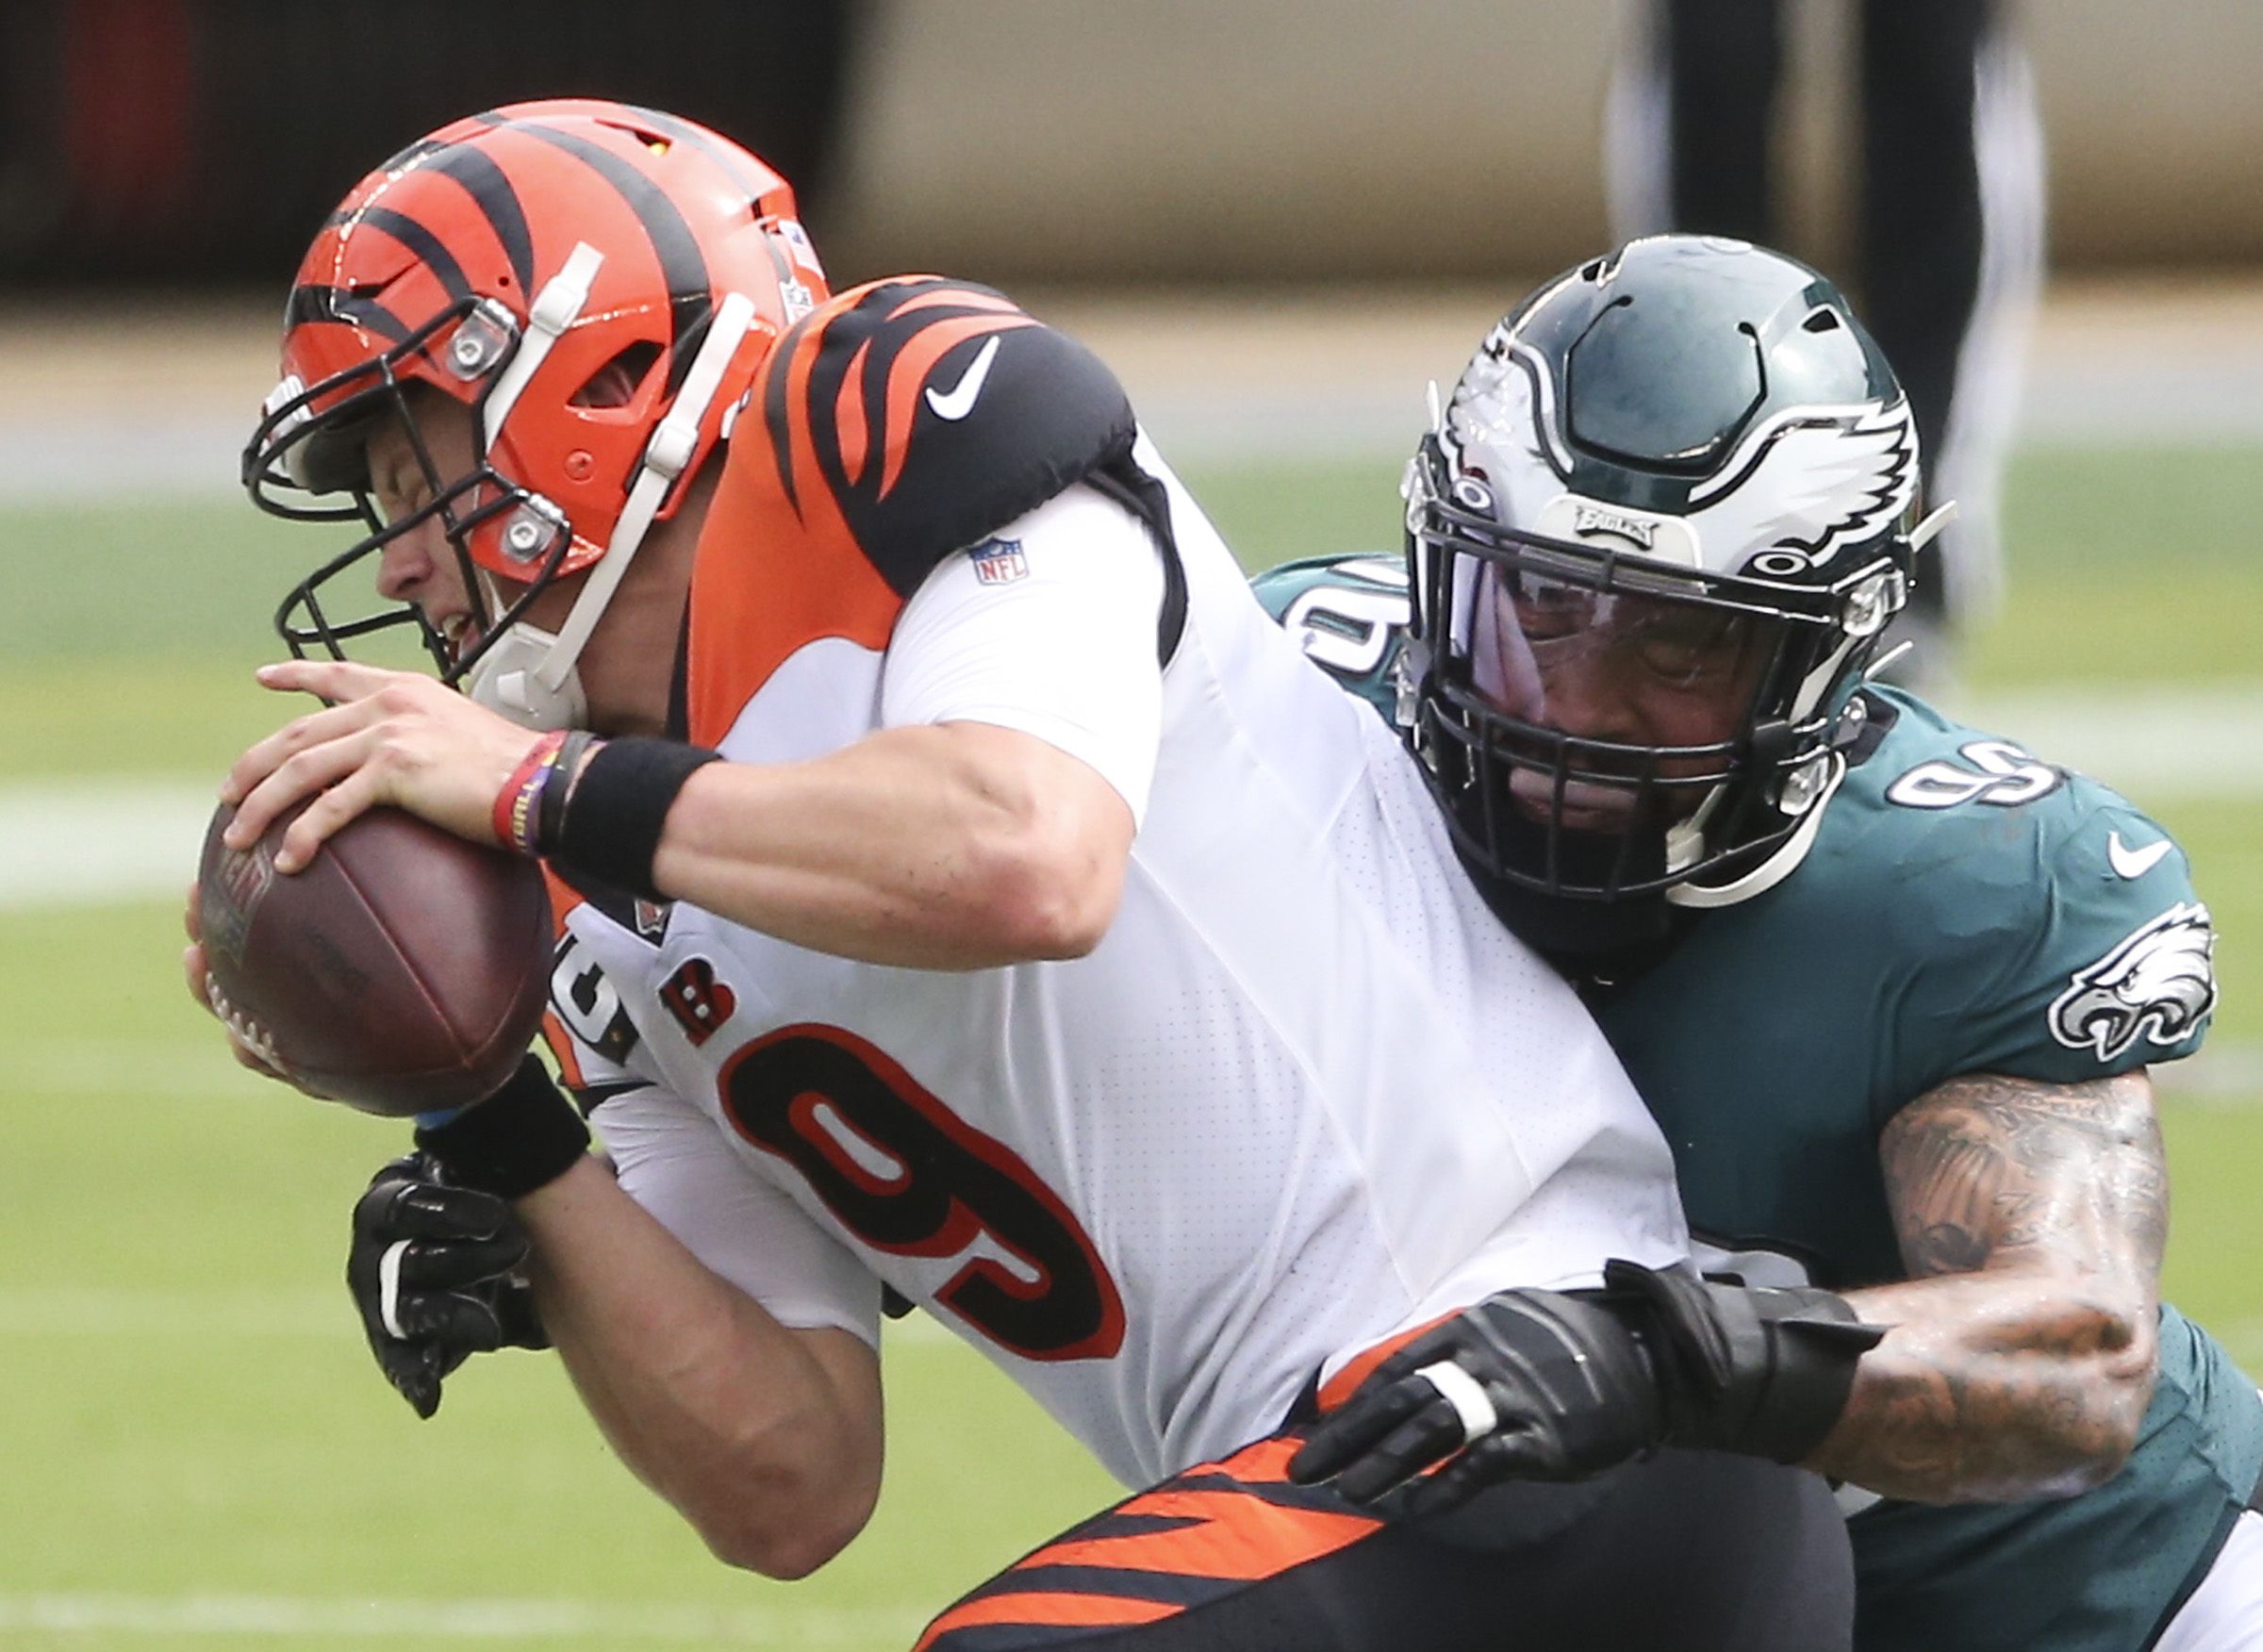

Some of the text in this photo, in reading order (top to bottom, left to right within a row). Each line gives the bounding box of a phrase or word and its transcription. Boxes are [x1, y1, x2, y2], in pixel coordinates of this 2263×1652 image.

[981, 555, 1026, 581] NFL
[657, 955, 738, 1049] B
[717, 1022, 1127, 1362] 9
